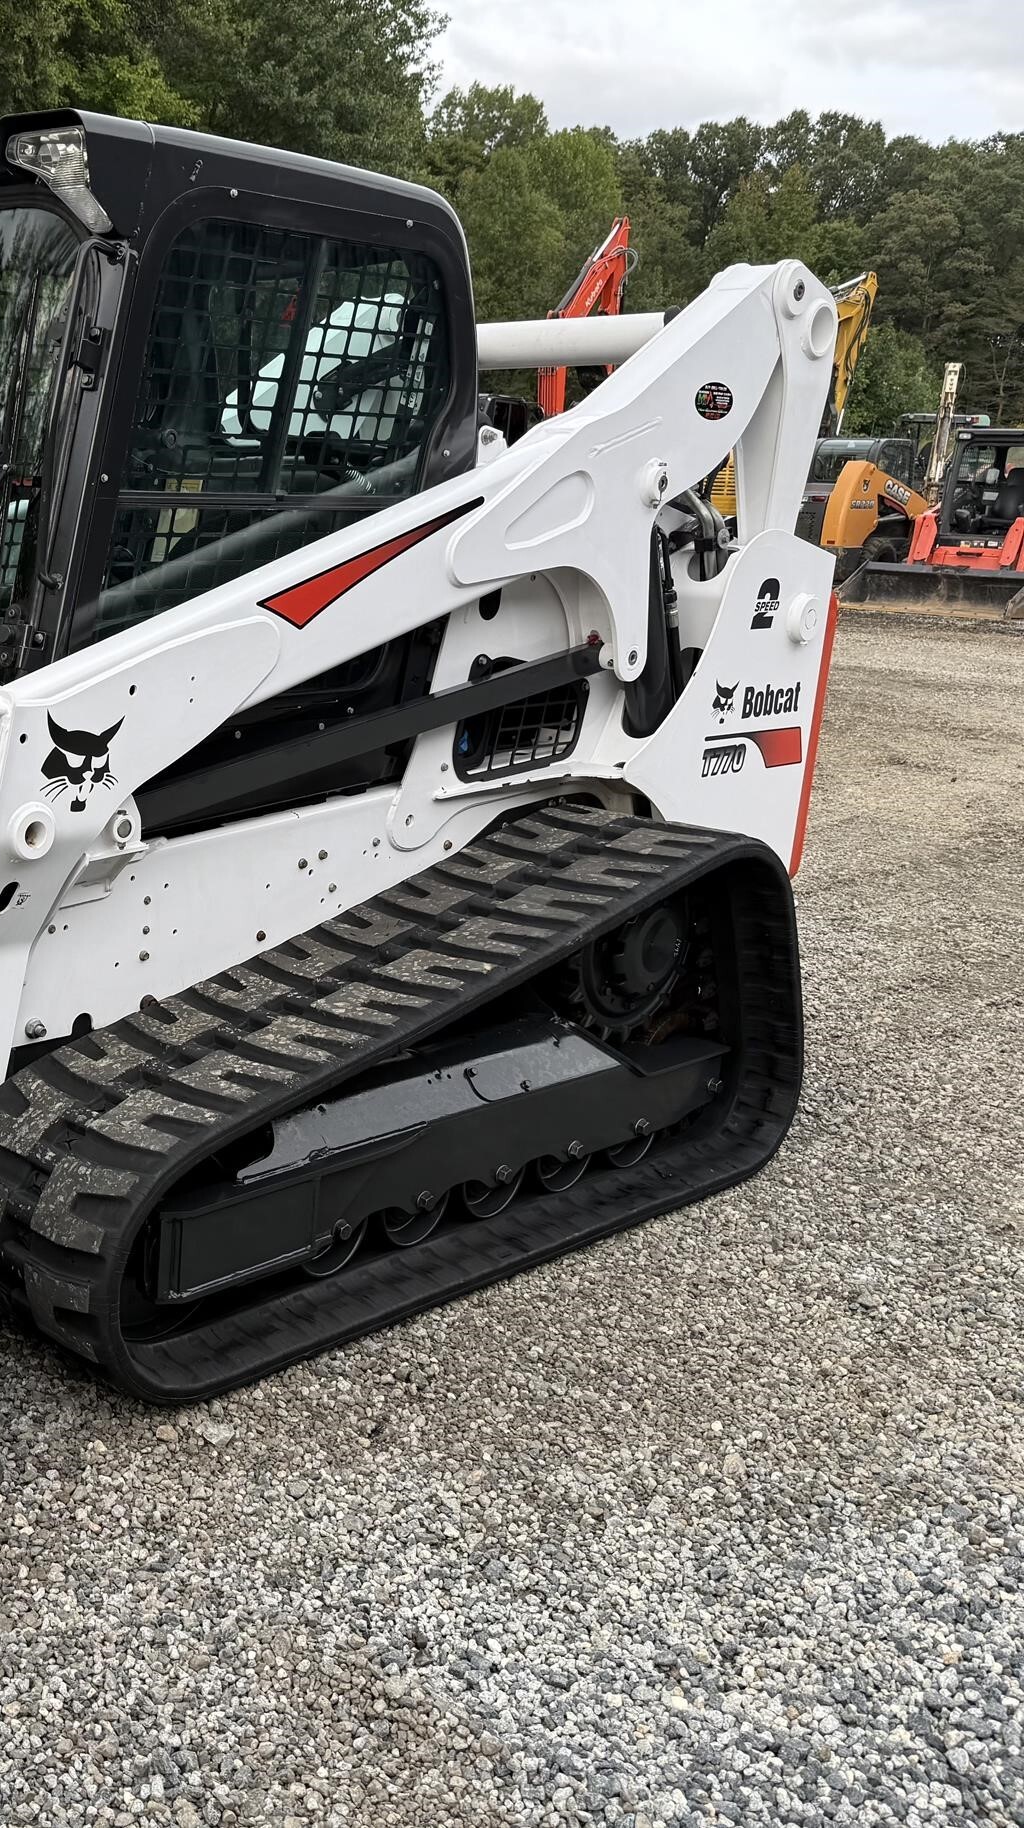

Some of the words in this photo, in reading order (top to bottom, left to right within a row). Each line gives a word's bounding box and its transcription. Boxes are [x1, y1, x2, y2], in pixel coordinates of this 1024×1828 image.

[884, 479, 911, 505] CASE
[750, 577, 781, 630] 2
[754, 601, 780, 612] SPEED
[741, 681, 801, 719] Bobcat
[701, 743, 746, 778] T770
